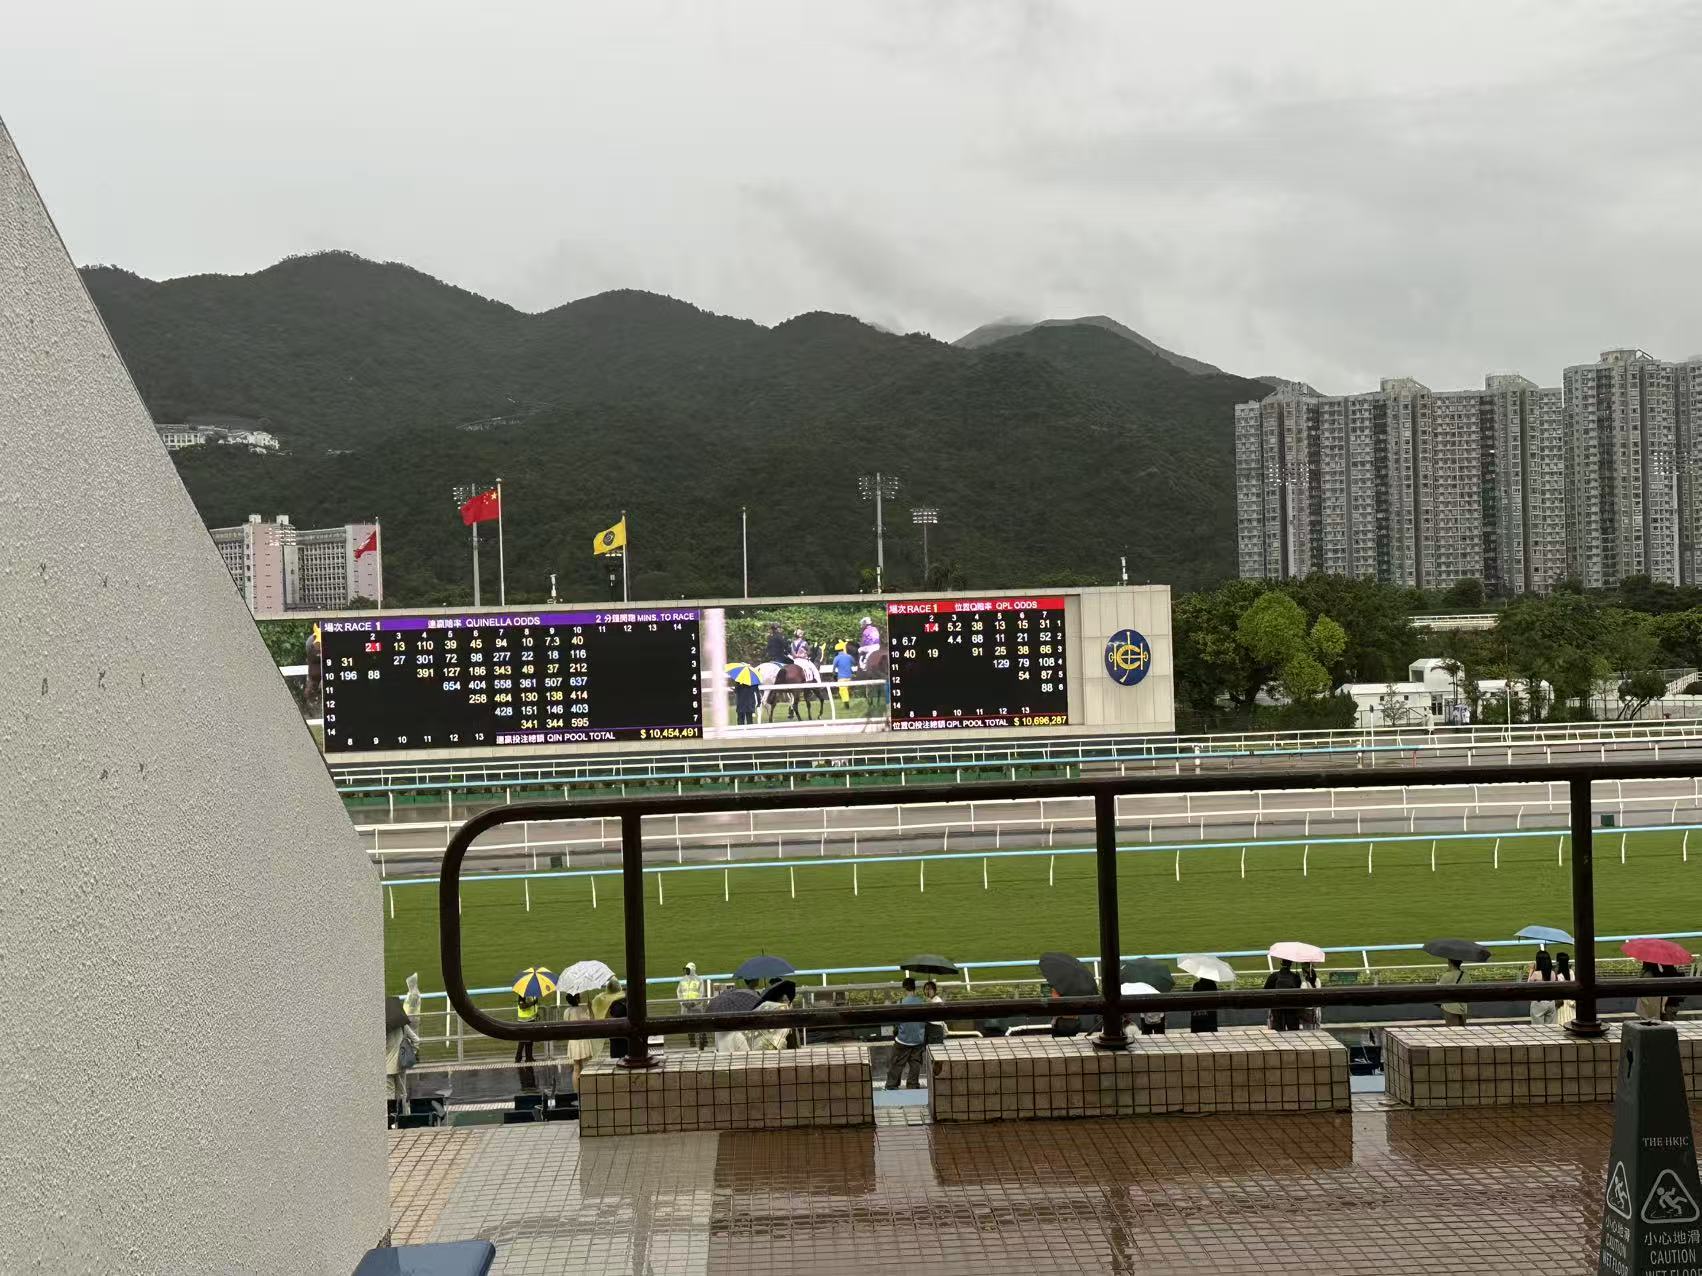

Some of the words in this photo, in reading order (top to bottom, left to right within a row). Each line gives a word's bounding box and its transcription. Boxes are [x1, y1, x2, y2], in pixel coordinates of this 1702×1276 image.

[907, 604, 931, 612] RACE
[933, 604, 938, 612] 1
[996, 602, 1012, 610] QPL
[466, 618, 512, 627] QUINELLA
[514, 617, 540, 625] ODDS
[638, 614, 658, 622] MINS.
[345, 623, 371, 631] RACE
[376, 622, 380, 630] 1
[927, 624, 939, 632] 1.4
[948, 623, 962, 631] 5.2
[972, 622, 982, 630] 38
[995, 622, 1005, 630] 13
[1018, 621, 1028, 629] 15
[1040, 620, 1049, 628] 31
[366, 643, 381, 652] 2.1
[394, 642, 405, 650] 13
[417, 641, 433, 650] 110
[445, 640, 456, 649] 39
[470, 640, 482, 648] 45
[496, 639, 507, 647] 94
[522, 638, 533, 646] 10
[545, 638, 560, 646] 7.3
[572, 637, 583, 645] 40
[902, 637, 916, 645] 6.7
[948, 636, 962, 644] 4.4
[972, 635, 983, 643] 68
[995, 634, 1005, 642] 11
[1017, 633, 1028, 641] 21
[1040, 632, 1051, 641] 52
[342, 658, 352, 666] 31
[394, 656, 406, 665] 27
[417, 655, 433, 664] 301
[446, 654, 457, 662] 72
[471, 654, 482, 662] 98
[493, 653, 511, 661] 277
[522, 652, 533, 660] 22
[548, 651, 559, 659] 18
[571, 650, 586, 659] 116
[904, 650, 916, 658] 40
[928, 649, 938, 658] 19
[972, 648, 983, 656] 91
[995, 647, 1006, 655] 25
[1018, 646, 1029, 654] 38
[1040, 646, 1052, 654] 66
[993, 660, 1009, 668] 129
[1018, 659, 1029, 667] 79
[1039, 658, 1054, 666] 108
[340, 671, 357, 680] 196
[368, 671, 380, 679] 88
[417, 669, 433, 678] 391
[443, 668, 460, 676] 127
[469, 667, 486, 675] 186
[494, 666, 511, 675] 343
[522, 665, 534, 674] 49
[548, 665, 559, 673] 37
[570, 664, 587, 672] 212
[1018, 672, 1030, 680] 54
[1041, 671, 1052, 679] 87
[443, 682, 460, 690] 654
[469, 681, 486, 689] 404
[494, 680, 511, 688] 558
[520, 679, 536, 687] 361
[545, 678, 562, 687] 507
[570, 677, 587, 685] 637
[1042, 684, 1052, 692] 88
[469, 695, 487, 703] 258
[521, 692, 538, 701] 130
[546, 692, 562, 700] 138
[570, 690, 588, 699] 414
[495, 707, 512, 716] 428
[521, 706, 537, 715] 151
[547, 705, 563, 714] 146
[571, 704, 588, 713] 403
[521, 720, 538, 728] 341
[546, 719, 563, 727] 344
[572, 718, 589, 727] 595
[947, 720, 961, 728] QPL
[963, 719, 983, 727] POOL
[985, 718, 1008, 726] TOTAL
[1023, 716, 1066, 724] 10,696,287
[548, 734, 562, 742] QIN
[641, 731, 646, 739] $
[650, 728, 698, 738] 10,454,491
[1643, 1137, 1662, 1147] THE
[1666, 1136, 1688, 1147] HKJC
[1644, 1230, 1700, 1246] 小心地滑
[1606, 1233, 1627, 1259] CAUTION
[1602, 1249, 1612, 1268] WET
[1650, 1249, 1696, 1264] CAUTION
